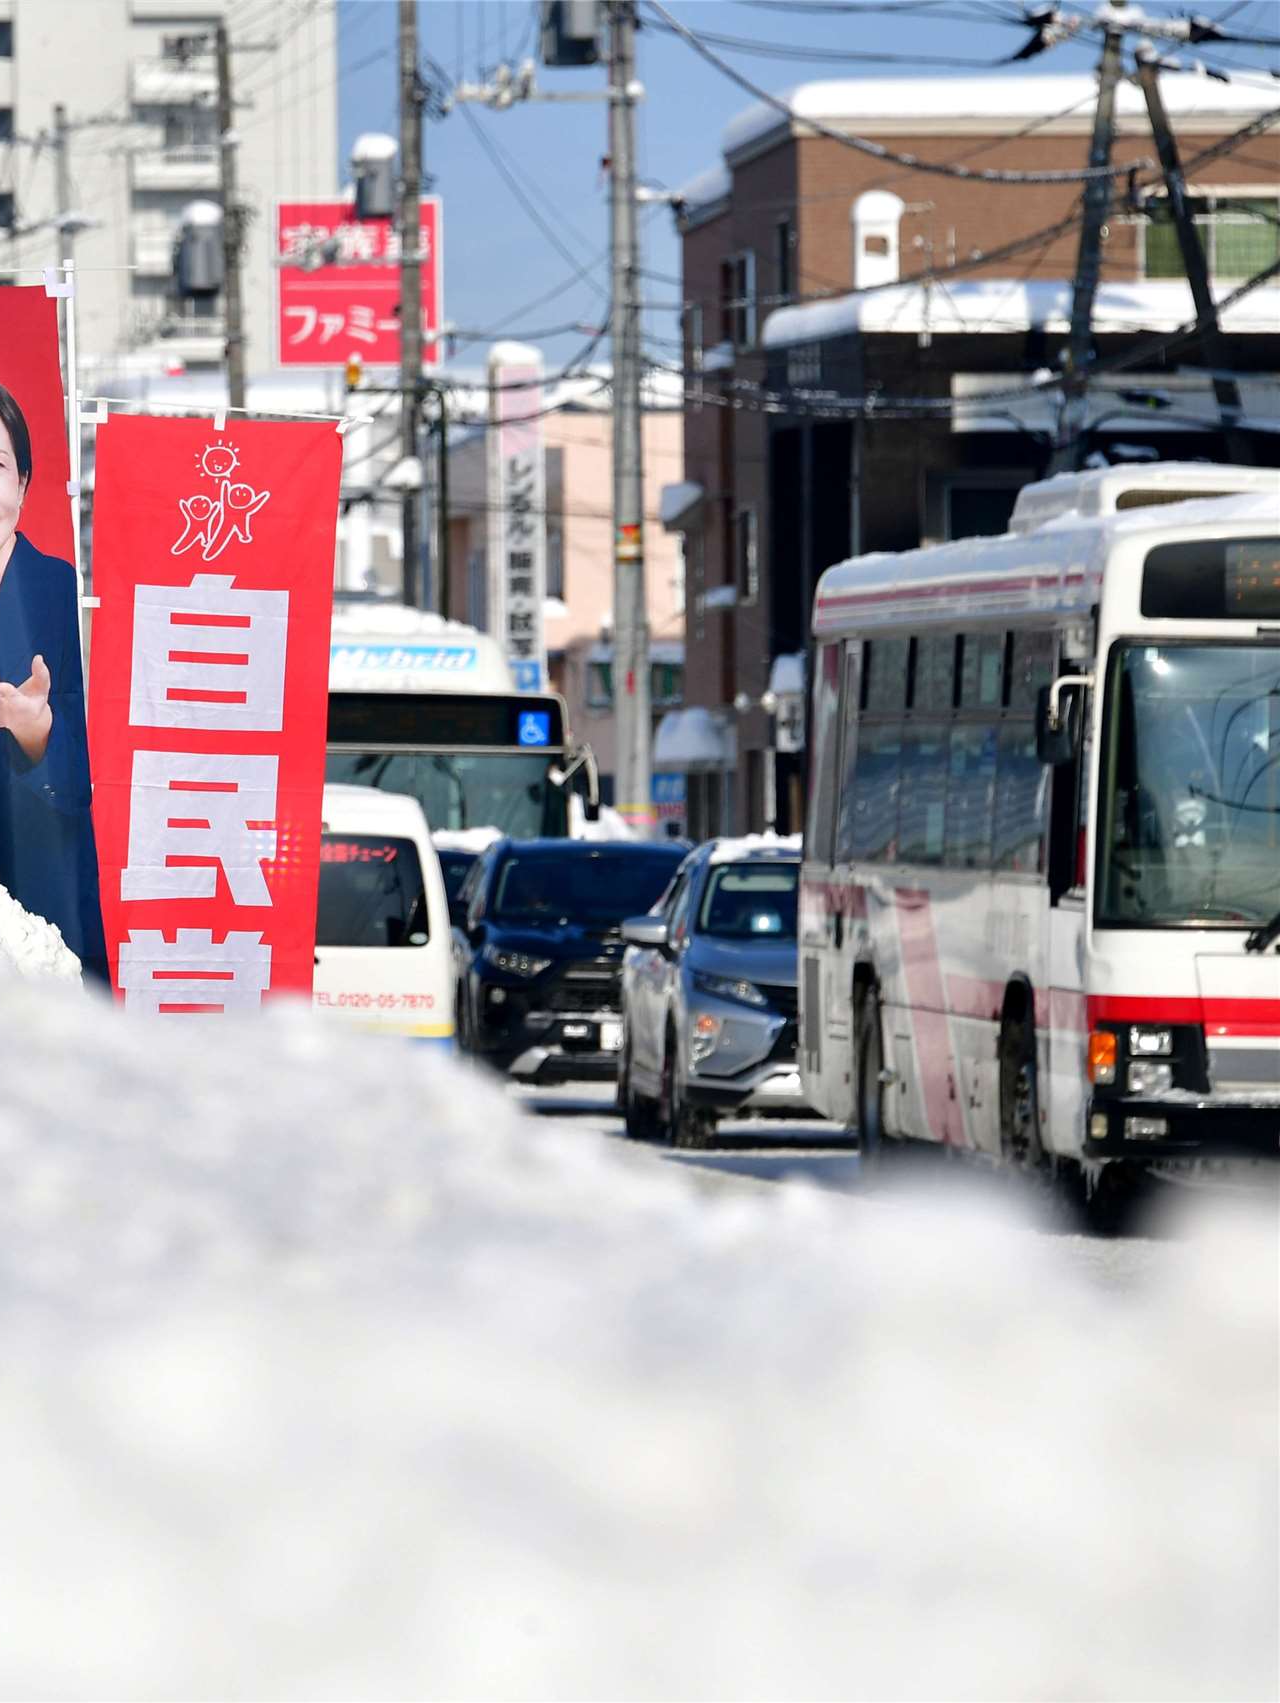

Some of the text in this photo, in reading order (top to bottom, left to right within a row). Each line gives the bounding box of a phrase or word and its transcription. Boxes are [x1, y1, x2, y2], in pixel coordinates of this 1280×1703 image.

[285, 305, 428, 345] ファミー
[119, 573, 289, 1022] 自民党
